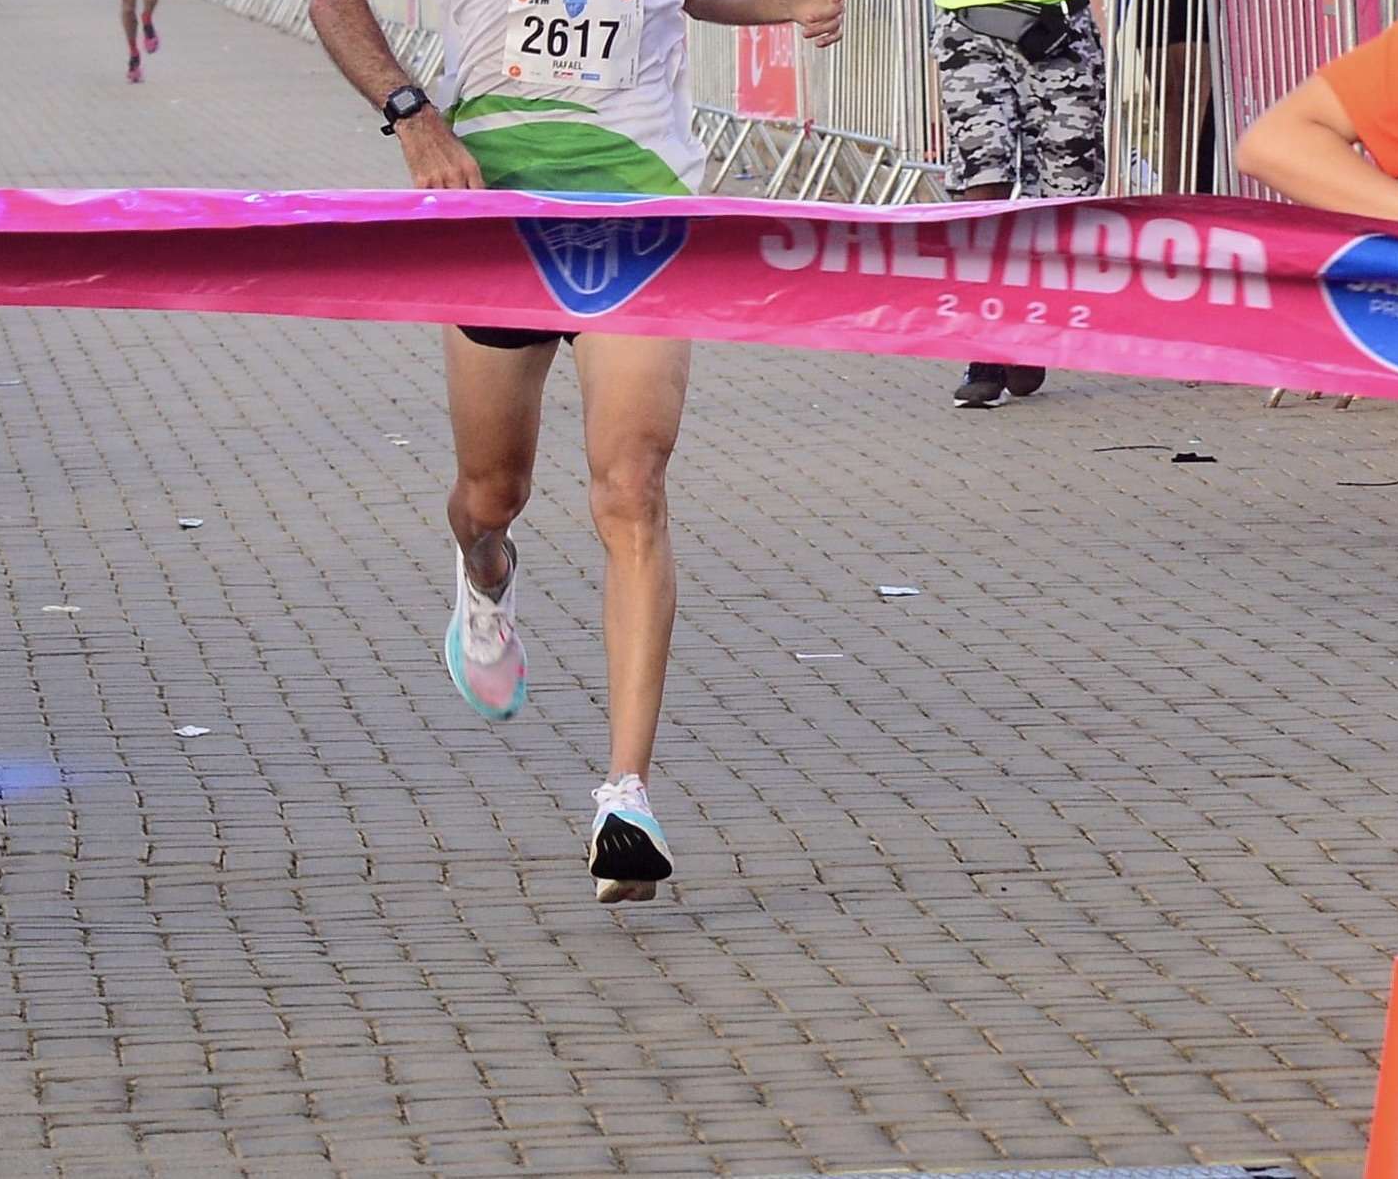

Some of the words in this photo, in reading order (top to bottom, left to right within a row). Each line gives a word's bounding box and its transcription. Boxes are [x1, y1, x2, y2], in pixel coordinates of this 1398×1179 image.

[521, 15, 620, 59] 2617
[552, 60, 583, 71] RAFAEL
[936, 293, 1092, 329] 2022
